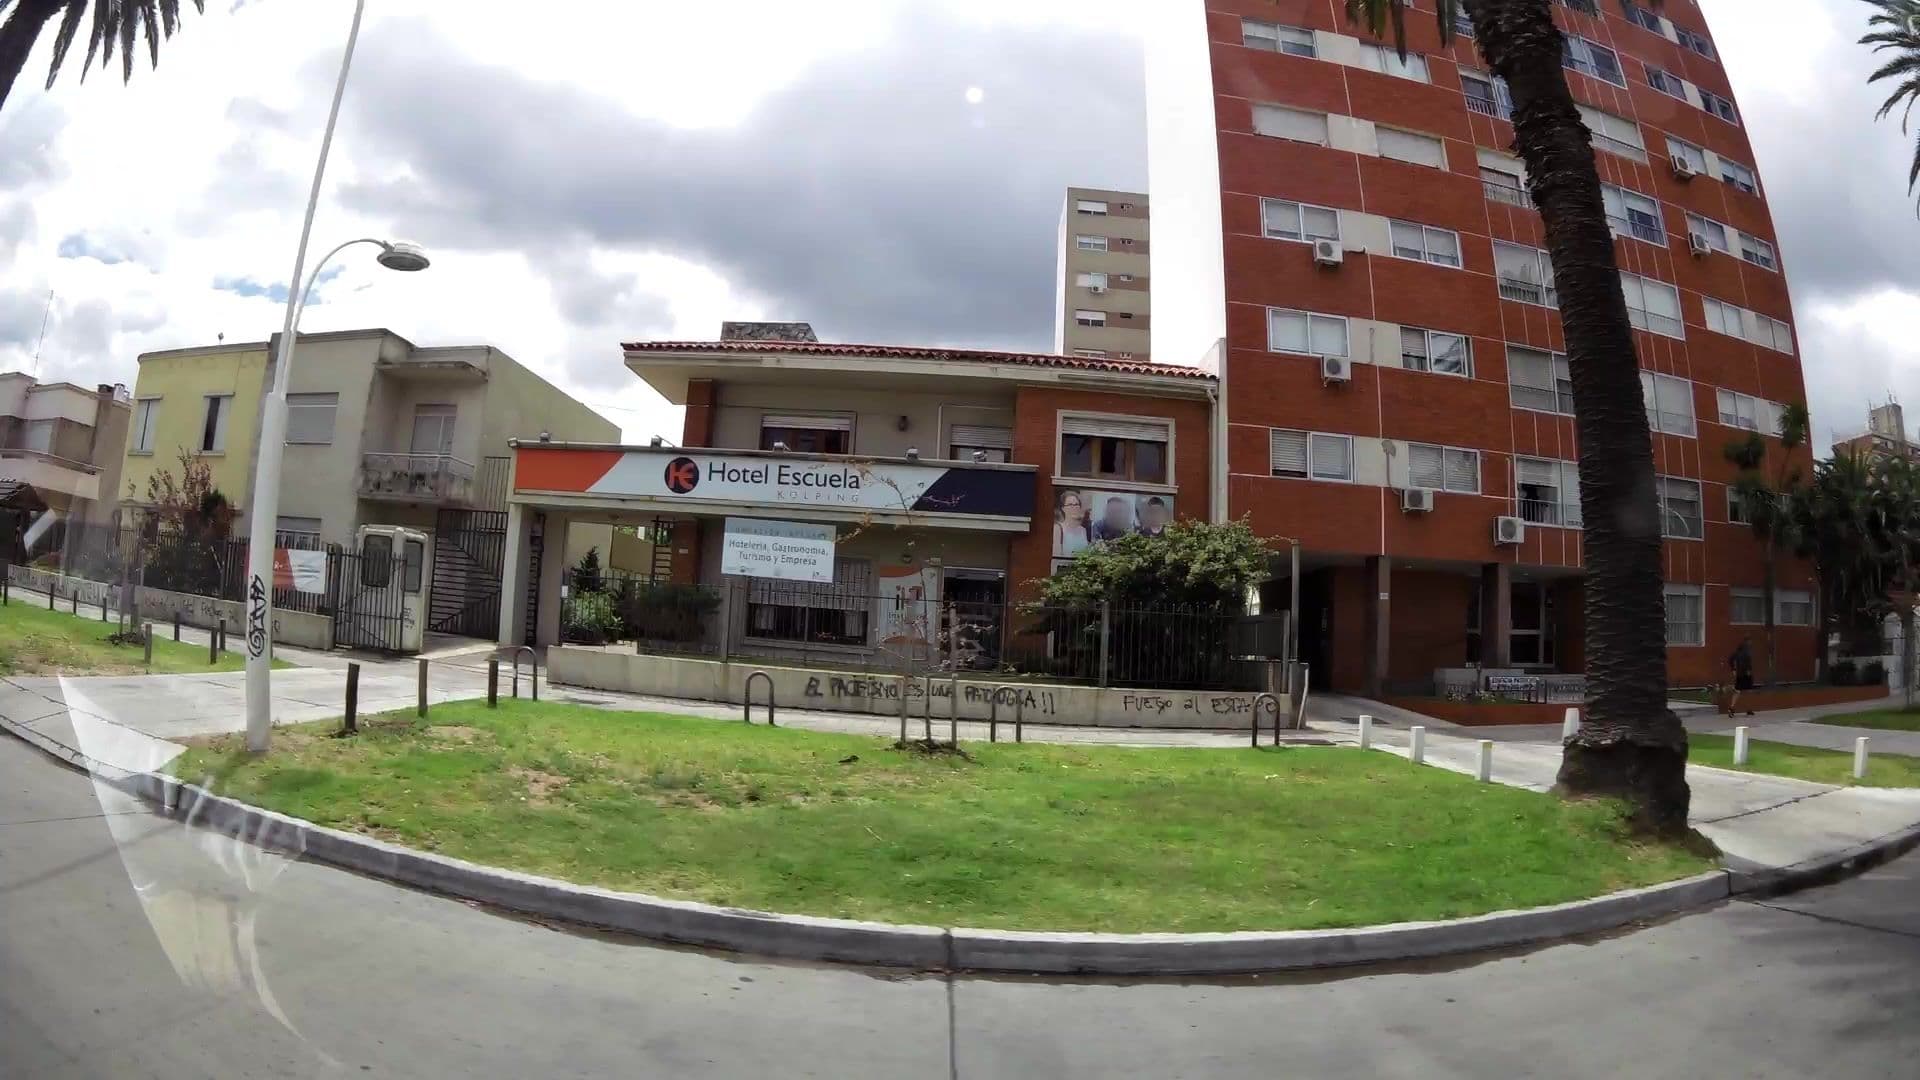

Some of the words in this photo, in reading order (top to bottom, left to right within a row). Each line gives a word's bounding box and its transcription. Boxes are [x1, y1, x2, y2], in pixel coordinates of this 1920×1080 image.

[708, 462, 769, 485] Hotel
[777, 464, 860, 490] Escuela
[777, 490, 860, 503] KOLPING
[738, 551, 771, 562] Turismo
[773, 555, 779, 564] y
[781, 555, 817, 566] Empresa
[805, 676, 823, 697] EL
